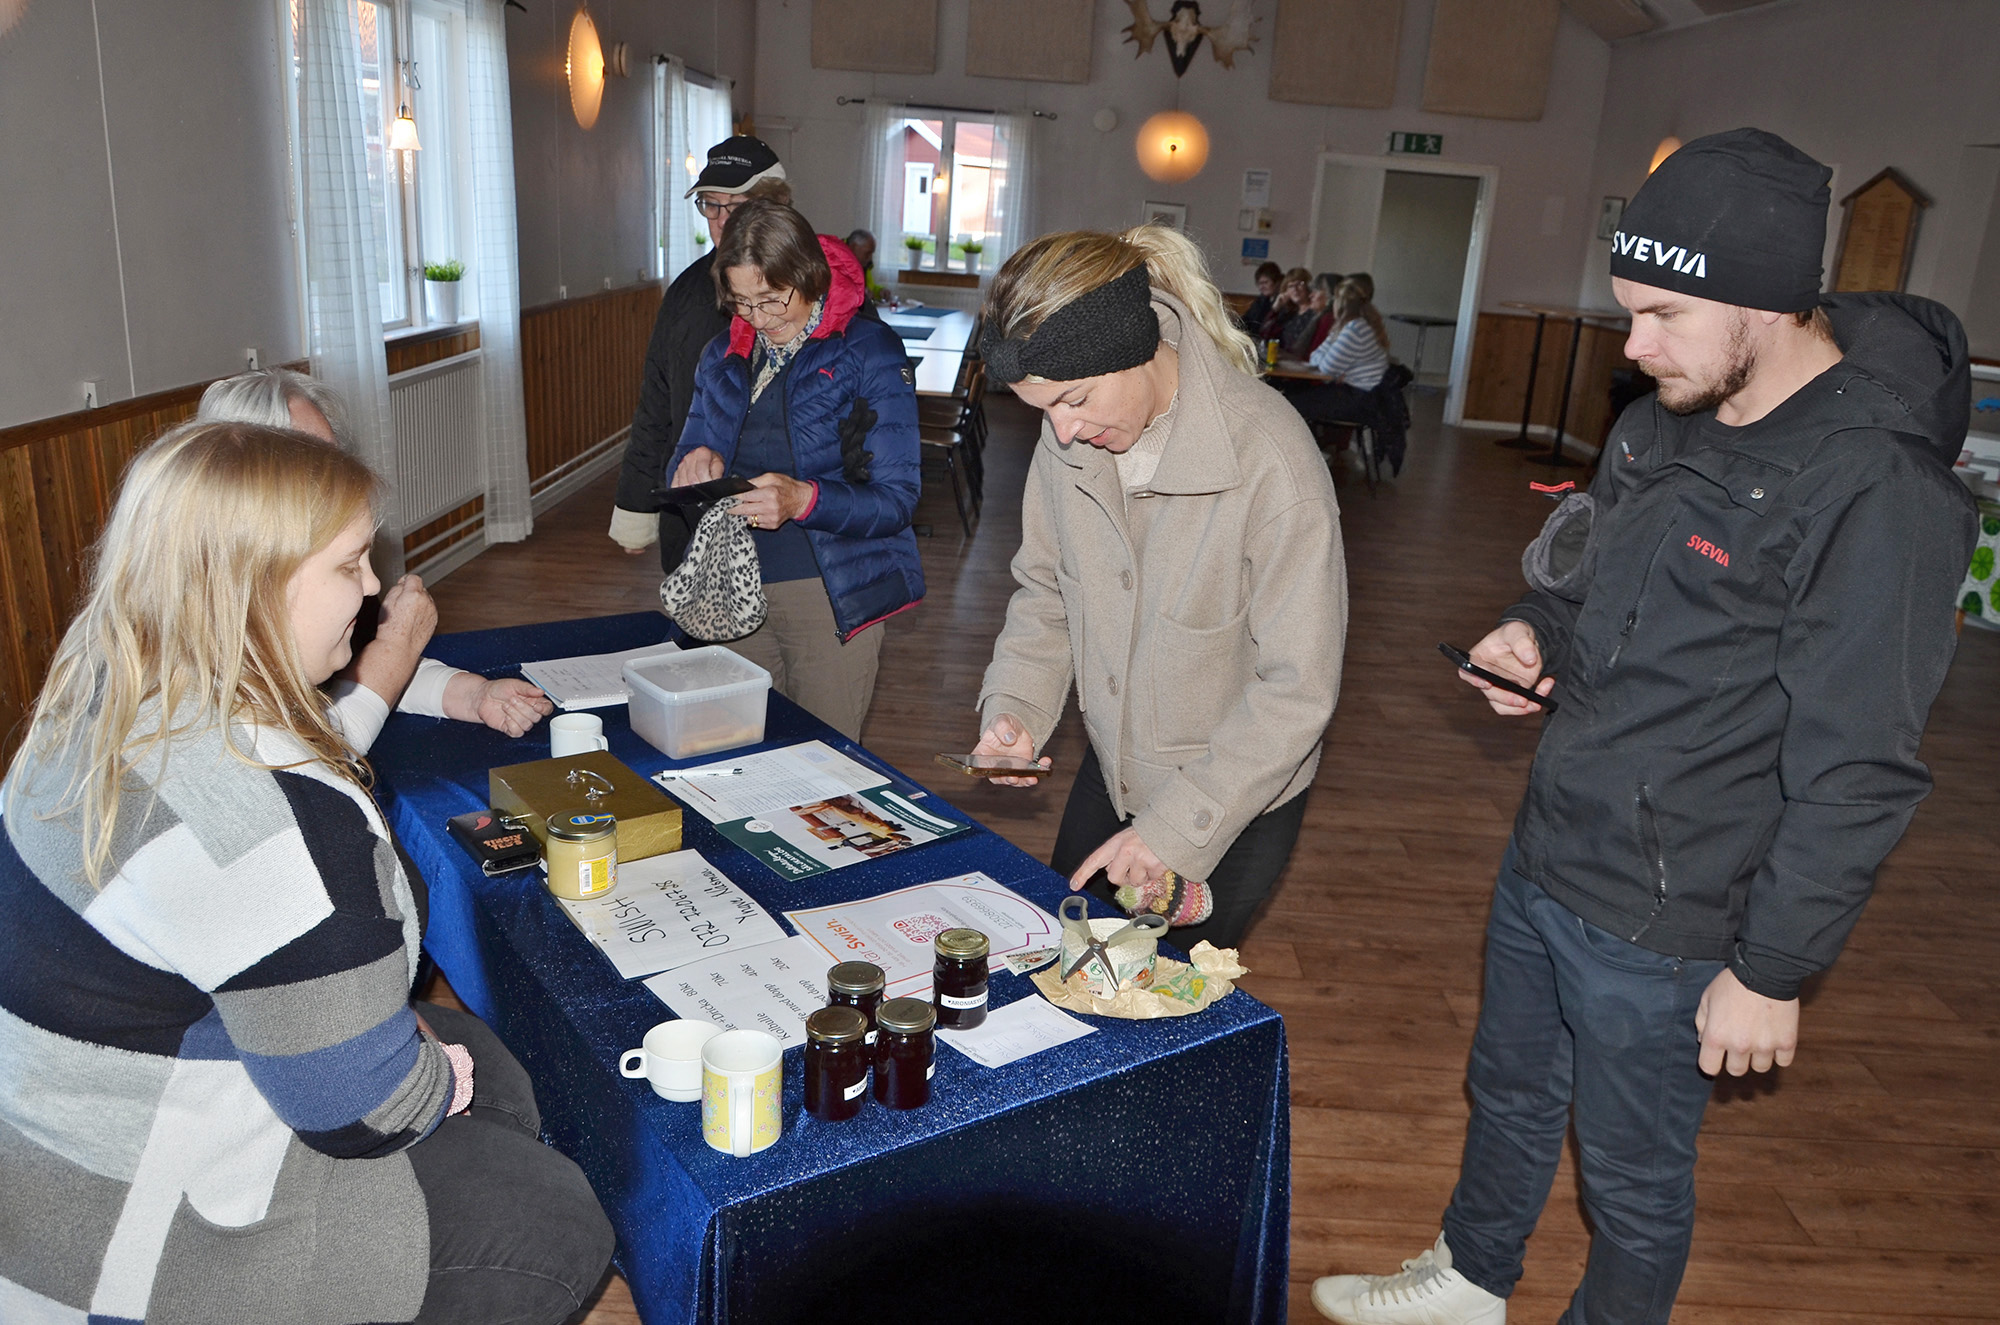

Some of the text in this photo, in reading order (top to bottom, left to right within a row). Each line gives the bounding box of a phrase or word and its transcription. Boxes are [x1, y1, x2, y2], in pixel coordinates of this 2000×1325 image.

[1611, 230, 1706, 278] SVEVIA
[1686, 534, 1730, 567] SVEVIA
[601, 896, 666, 944] SWISH
[690, 920, 730, 948] 072
[826, 917, 865, 950] Swish.
[740, 962, 758, 977] 40kr
[770, 957, 790, 972] 20kr
[678, 981, 698, 997] 80kr
[764, 982, 785, 999] dopp
[799, 979, 819, 996] dopp
[709, 971, 791, 1041] Kolbulle 70kr
[782, 998, 801, 1017] med
